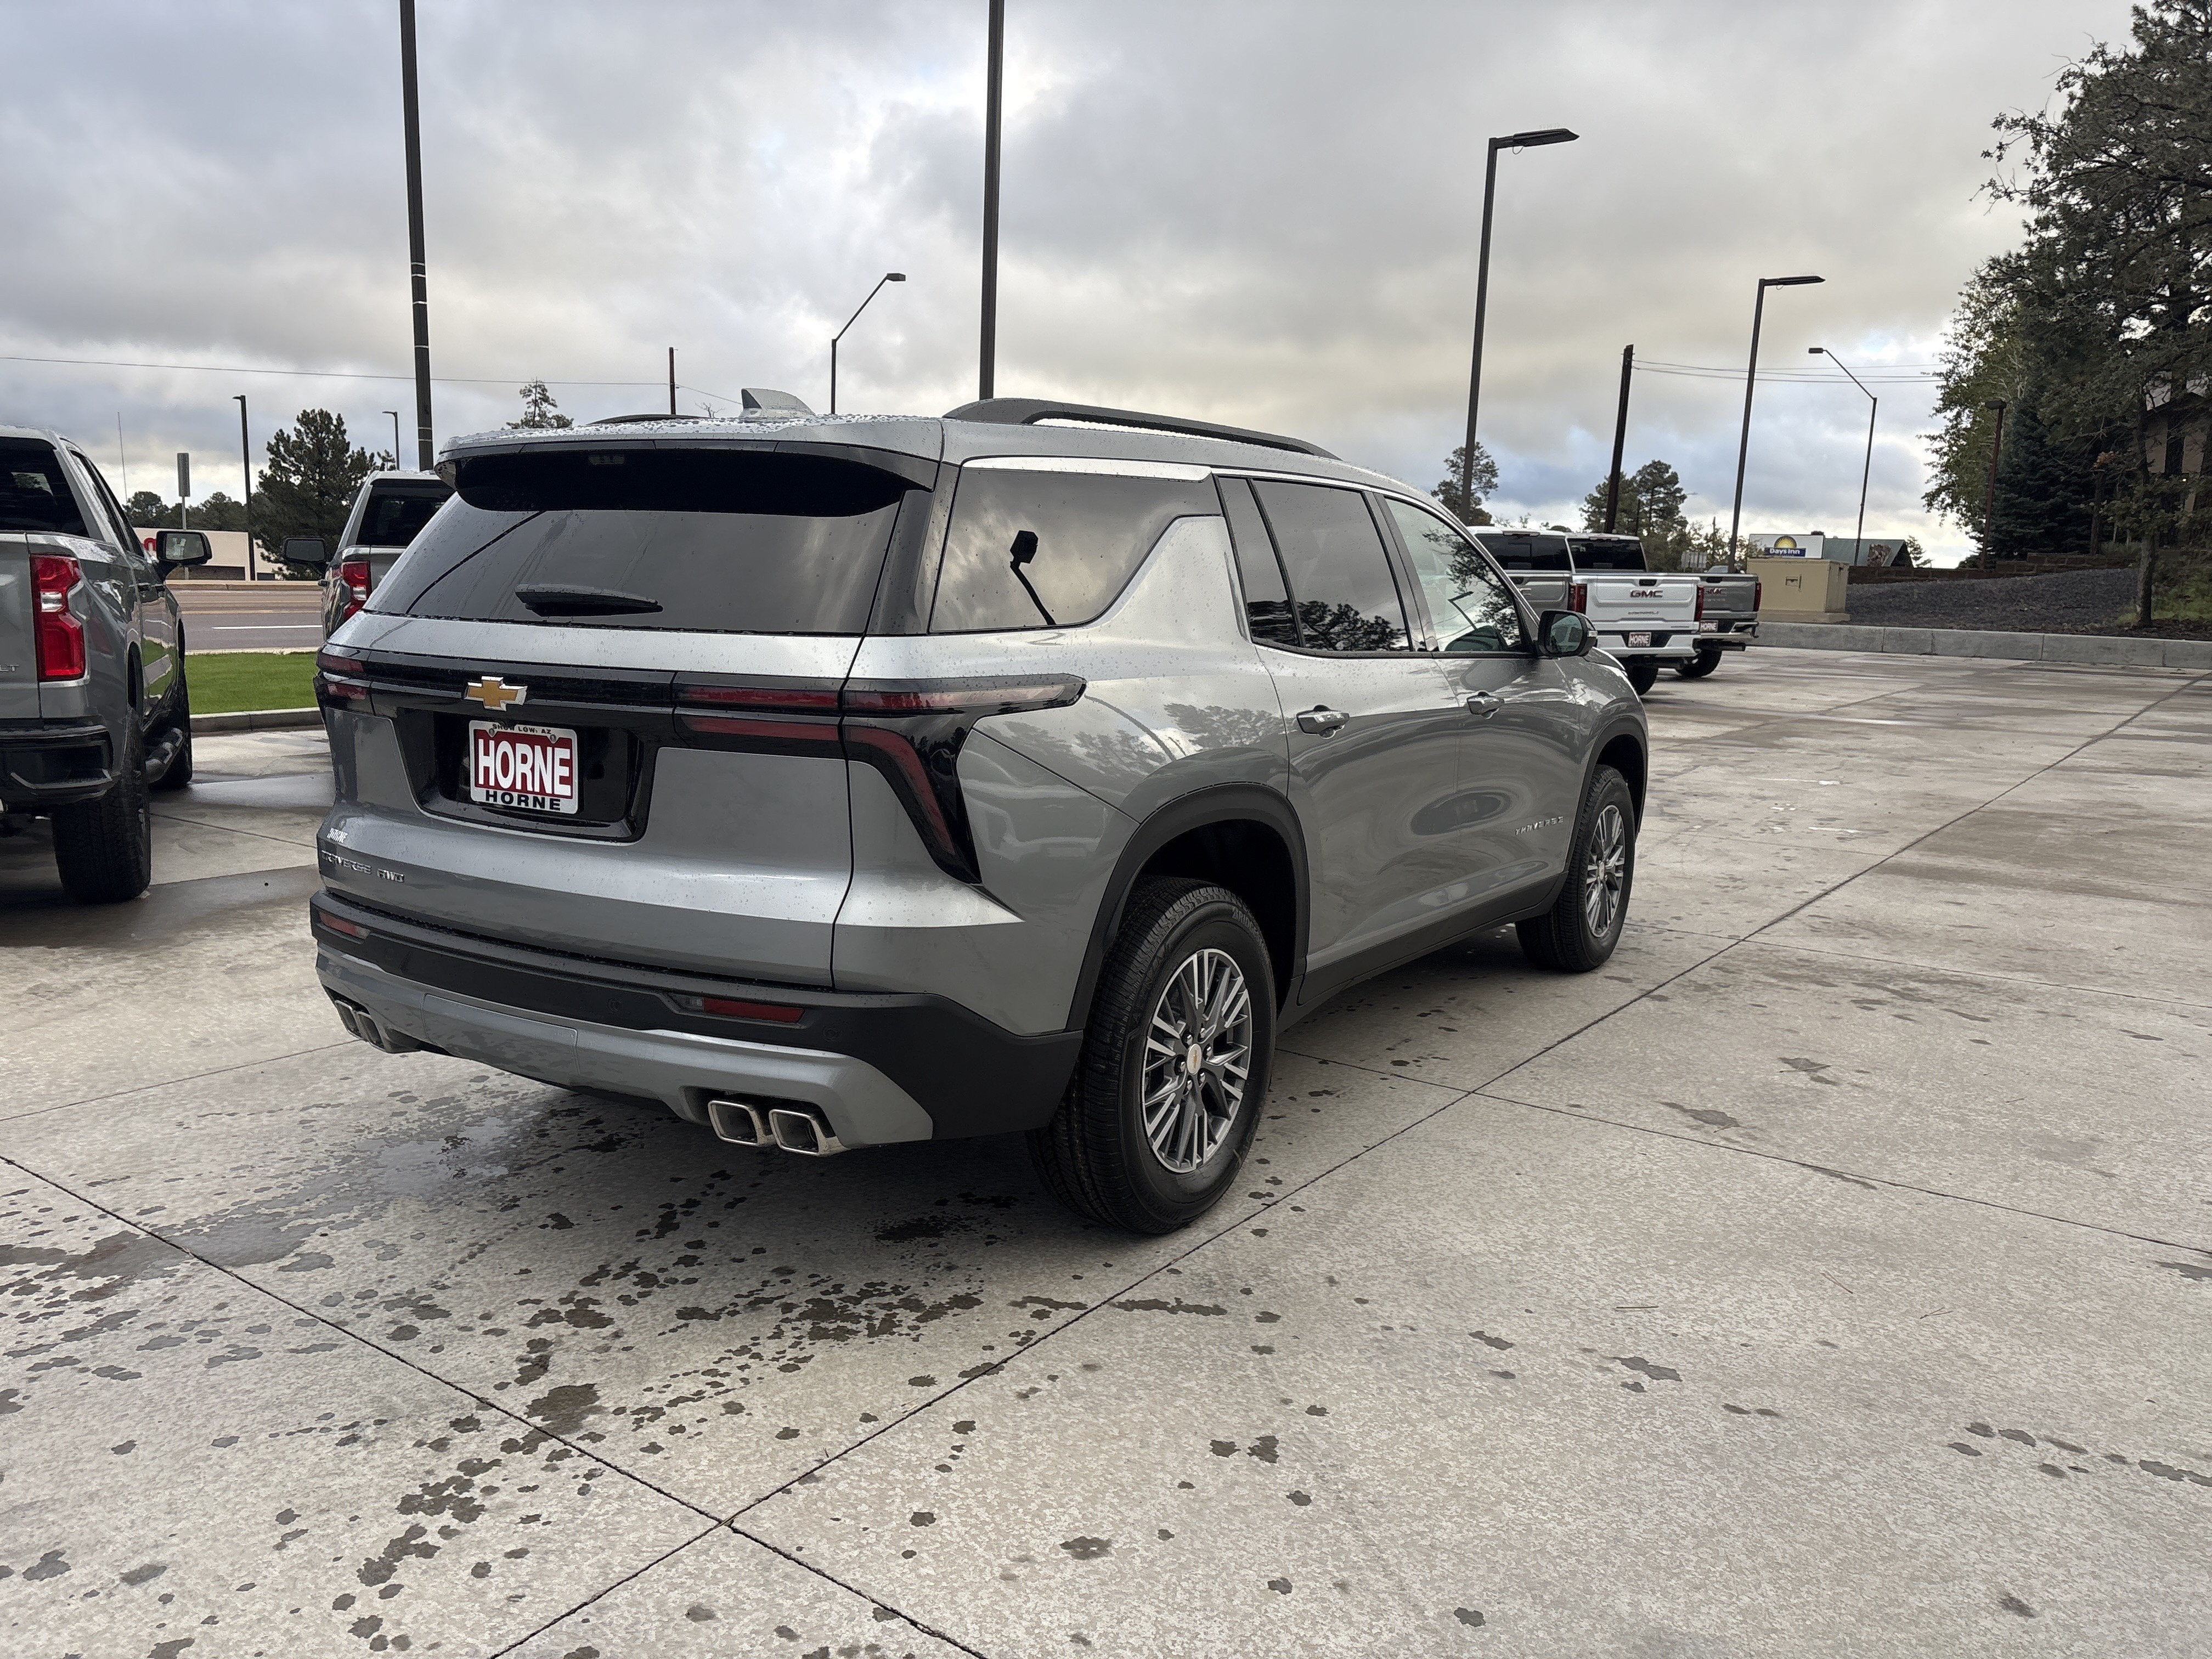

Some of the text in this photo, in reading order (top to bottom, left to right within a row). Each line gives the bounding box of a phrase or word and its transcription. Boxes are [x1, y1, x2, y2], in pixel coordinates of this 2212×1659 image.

[1630, 635, 1649, 644] HORNE
[478, 738, 571, 796] HORNE
[486, 790, 561, 811] HORNE
[1515, 816, 1564, 835] TRAVERSE
[321, 850, 371, 874] TRAVERSE
